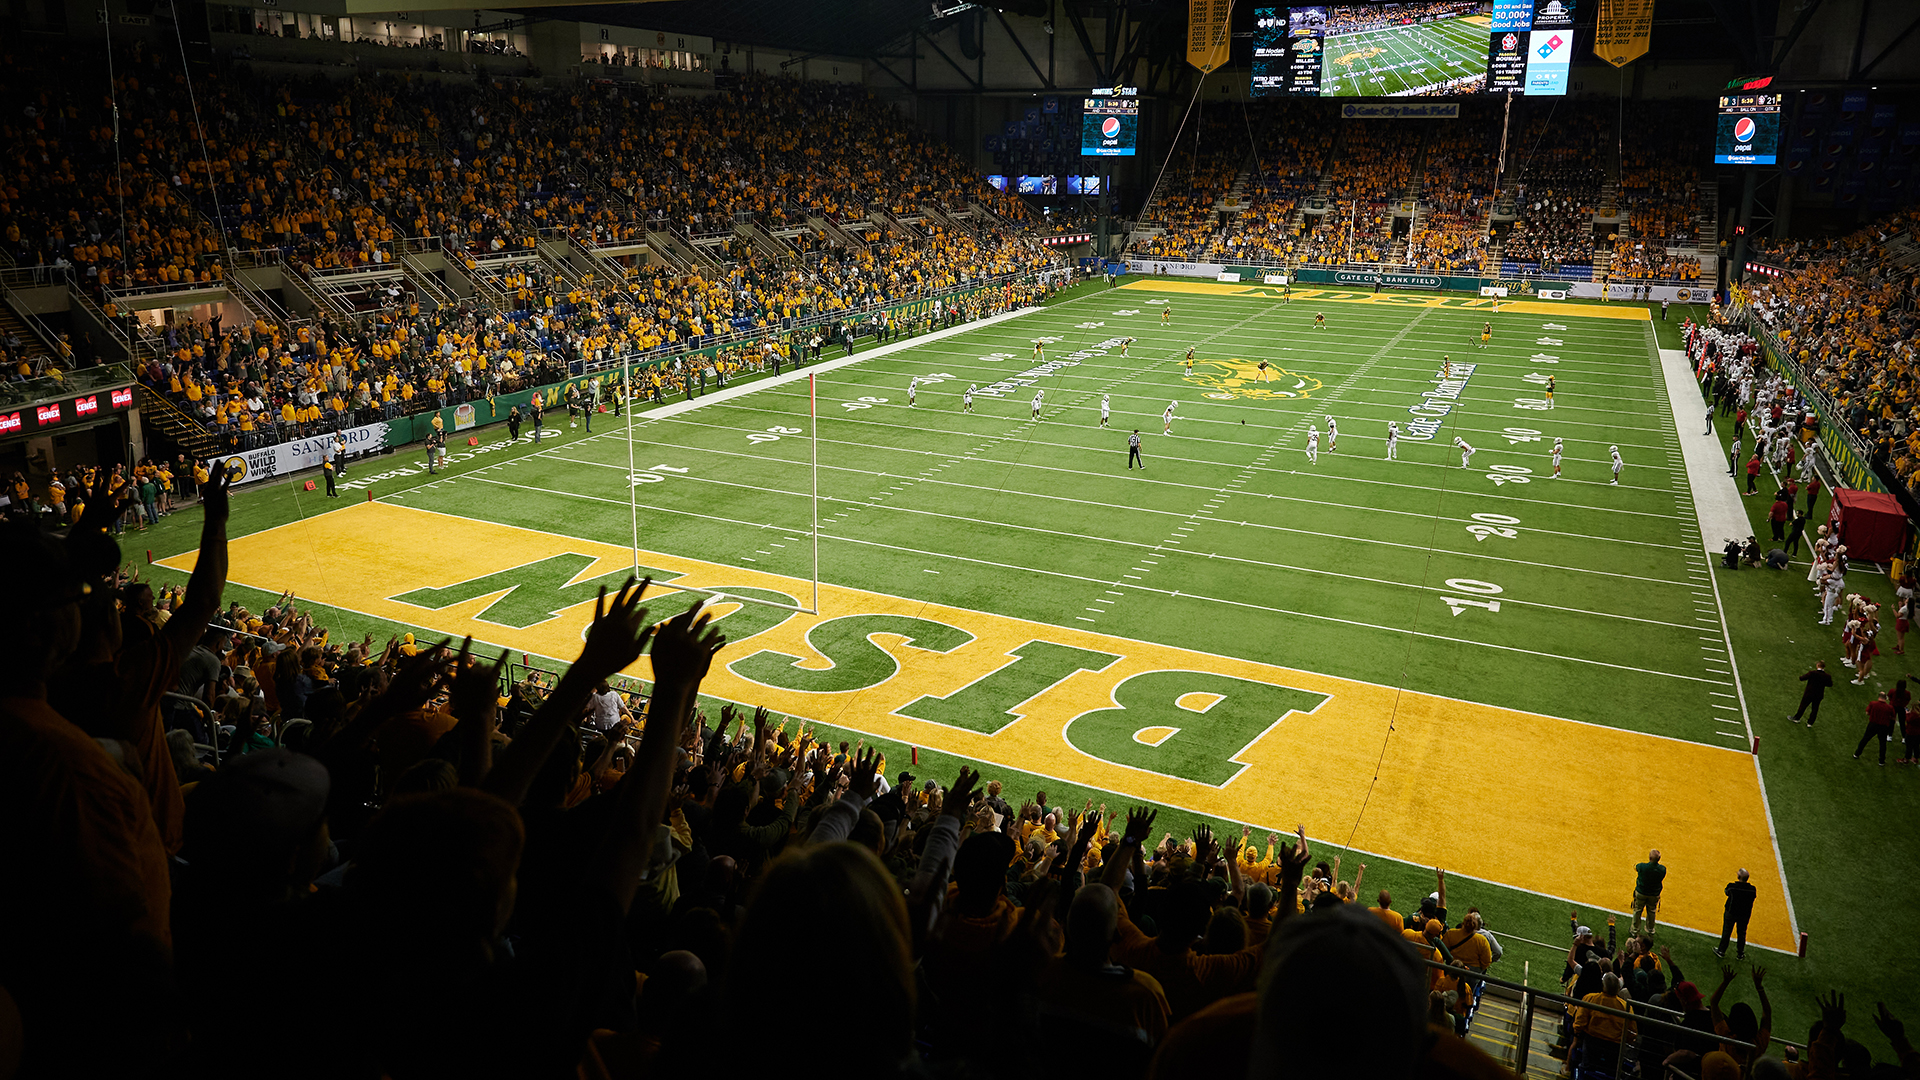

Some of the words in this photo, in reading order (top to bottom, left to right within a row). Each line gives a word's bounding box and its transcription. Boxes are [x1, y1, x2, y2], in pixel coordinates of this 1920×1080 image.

[121, 16, 147, 24] EAST
[1495, 11, 1531, 20] 50,000+
[1121, 87, 1138, 95] STAR
[1357, 105, 1380, 116] Gate
[1380, 105, 1401, 117] City
[1402, 105, 1429, 116] Bank
[1430, 105, 1457, 116] Field
[1735, 226, 1745, 235] 14
[112, 393, 132, 404] CENEX
[76, 401, 97, 412] CENEX
[1408, 397, 1466, 418] City
[38, 409, 60, 421] CENEX
[746, 425, 803, 442] 20
[1501, 427, 1542, 443] 40
[248, 449, 276, 461] BUFFALO
[248, 456, 277, 470] WILD
[250, 465, 277, 477] WINGS
[625, 463, 690, 484] 10
[1485, 465, 1533, 484] 30
[1465, 513, 1521, 539] 20
[1440, 578, 1504, 613] 10
[387, 551, 1337, 788] BISON
